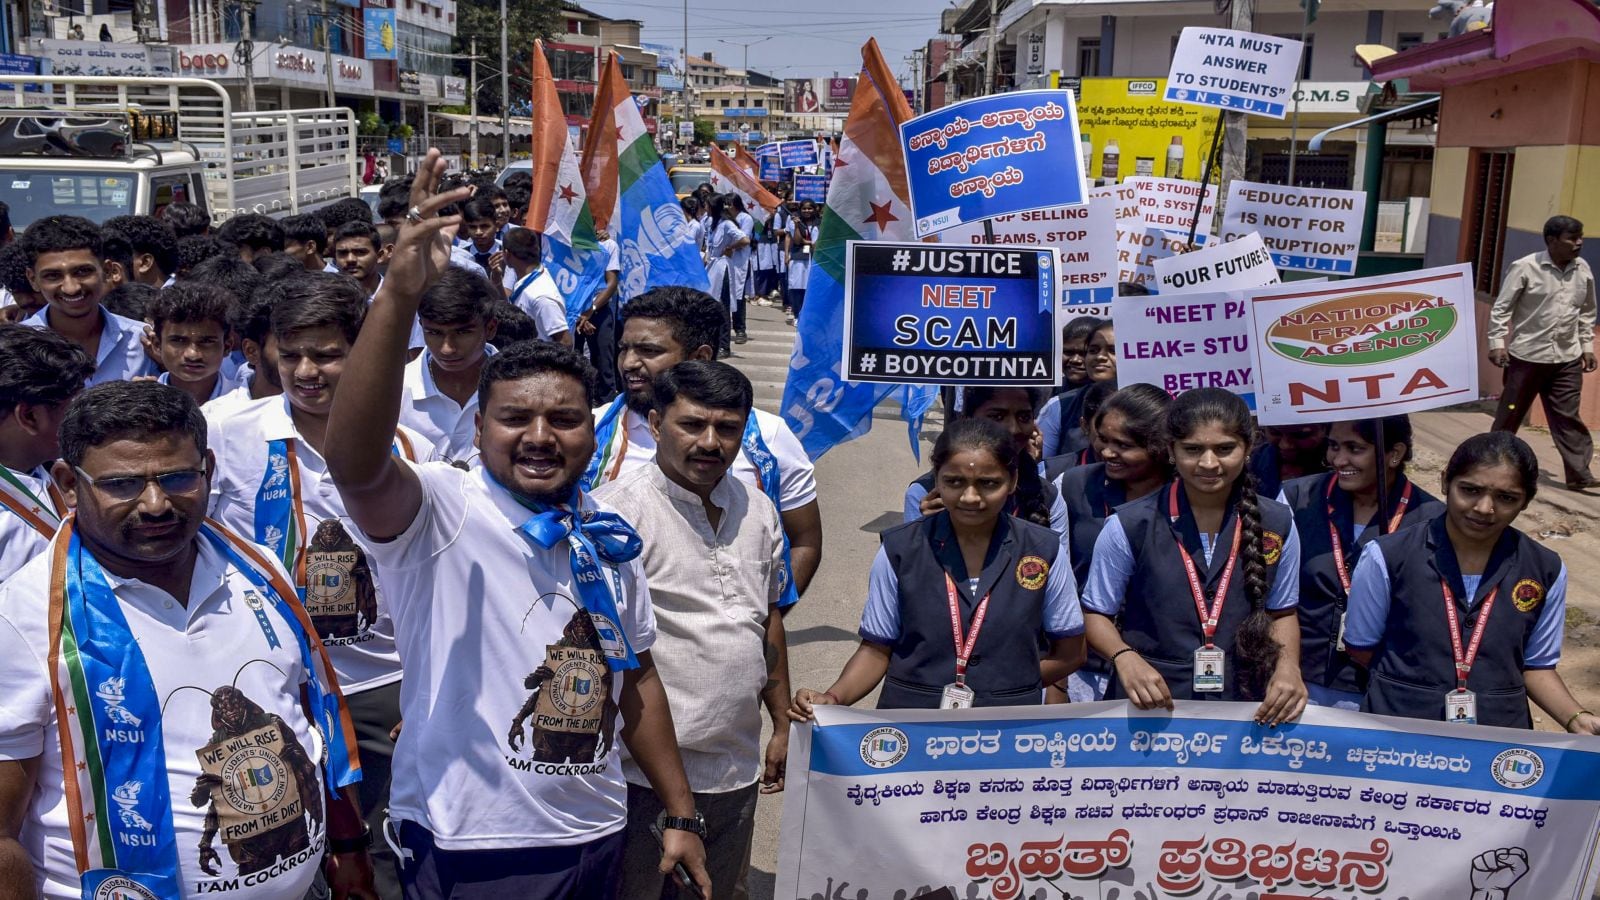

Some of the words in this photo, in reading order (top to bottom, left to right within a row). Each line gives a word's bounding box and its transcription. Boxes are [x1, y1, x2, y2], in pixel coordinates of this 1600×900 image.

[1199, 33, 1235, 48] “NTA
[1239, 38, 1283, 56] MUST
[179, 51, 229, 70] baco
[1202, 55, 1268, 74] ANSWER
[1132, 82, 1153, 90] IFFCO
[1175, 72, 1195, 85] TO
[1198, 76, 1286, 98] STUDENTS”
[927, 132, 1046, 175] ವಿದ್ಯಾರ್ಥಿಗಳಿಗೆ
[949, 166, 1023, 199] ಅನ್ಯಾಯ
[1116, 188, 1135, 200] TO
[1164, 199, 1212, 214] SYSTM
[1238, 189, 1354, 210] “EDUCATION
[932, 216, 949, 227] NSUI
[1021, 208, 1089, 222] SELLING
[1240, 212, 1258, 224] IS
[1263, 215, 1304, 230] NOT
[1308, 218, 1345, 233] FOR
[1046, 230, 1087, 244] STOP
[1129, 232, 1154, 247] NO
[1224, 232, 1355, 256] CRUPTION”
[892, 250, 1022, 274] #JUSTICE
[1163, 266, 1210, 289] “OUR
[1215, 250, 1263, 279] FUTURE
[922, 284, 996, 309] NEET
[1145, 303, 1217, 325] “NEET
[1279, 296, 1455, 327] NATIONAL
[893, 314, 1017, 349] SCAM
[1311, 315, 1429, 341] FRAUD
[1123, 340, 1195, 359] LEAK=
[1203, 334, 1248, 355] STU
[1300, 330, 1443, 359] AGENCY
[860, 353, 877, 372] #
[885, 355, 1048, 377] BOYCOTTNTA
[1163, 367, 1254, 391] BETRAY
[1288, 367, 1449, 407] NTA
[314, 554, 335, 562] WILL
[337, 554, 355, 564] RISE
[1193, 581, 1204, 600] COLLEGE
[321, 604, 335, 613] THE
[337, 602, 355, 612] DIRT
[550, 650, 564, 661] WE
[567, 650, 588, 661] WILL
[552, 678, 568, 711] NATIONAL
[536, 714, 563, 728] FROM
[566, 718, 580, 729] THE
[581, 718, 600, 730] DIRT
[105, 729, 145, 744] NSUI
[203, 748, 225, 765] WE
[226, 738, 253, 755] WILL
[253, 729, 279, 747] RISE
[259, 750, 281, 771] UNION
[925, 729, 1001, 759] ಭಾರತ
[1015, 727, 1117, 768] ರಾಷ್ಟ್ರೀಯ
[1130, 730, 1228, 765] ವಿದ್ಯಾರ್ಥಿ
[1240, 731, 1332, 769] ಒಕ್ಕೂಟ,
[1346, 746, 1471, 774] ಚಿಕ್ಕಮಗಳೂರು
[278, 769, 286, 780] OF
[504, 755, 532, 772] ’AM
[535, 762, 607, 776] COCKROACH
[223, 782, 255, 812] NATIONAL
[271, 779, 286, 802] INDIA
[847, 779, 924, 806] ವೈದ್ಯಕೀಯ
[932, 779, 971, 800] ಶಿಕ್ಷಣ
[979, 777, 1025, 794] ಕನಸು
[1032, 776, 1073, 797] ಹೊತ್ತ
[1080, 775, 1180, 799] ವಿದ್ಯಾರ್ಥಿಗಳಿಗೆ
[1187, 777, 1249, 799] ಅನ್ಯಾಯ
[1257, 779, 1351, 803] ಮಾಡುತ್ತಿರುವ
[1360, 787, 1408, 810] ಕೇಂದ್ರ
[1415, 793, 1491, 815] ಸರ್ಕಾರದ
[1499, 803, 1549, 830] ವಿರುದ್ಧ
[226, 819, 259, 839] FROM
[260, 812, 280, 828] THE
[280, 800, 300, 820] DIRT
[919, 806, 968, 824] ಹಾಗೂ
[976, 805, 1022, 825] ಕೇಂದ್ರ
[1029, 803, 1067, 825] ಶಿಕ್ಷಣ
[1074, 803, 1114, 819] ಸಚಿವ
[1213, 806, 1269, 824] ಪ್ರಧಾನ್
[1277, 808, 1377, 831] ರಾಜೀನಾಮೆಗೆ
[1384, 818, 1462, 841] ಒತ್ತಾಯಿಸಿ
[119, 832, 157, 847] NSUI
[965, 828, 1134, 900] ಬೃಹತ್
[1156, 833, 1394, 896] ಪ್ರತಿಭಟನೆ
